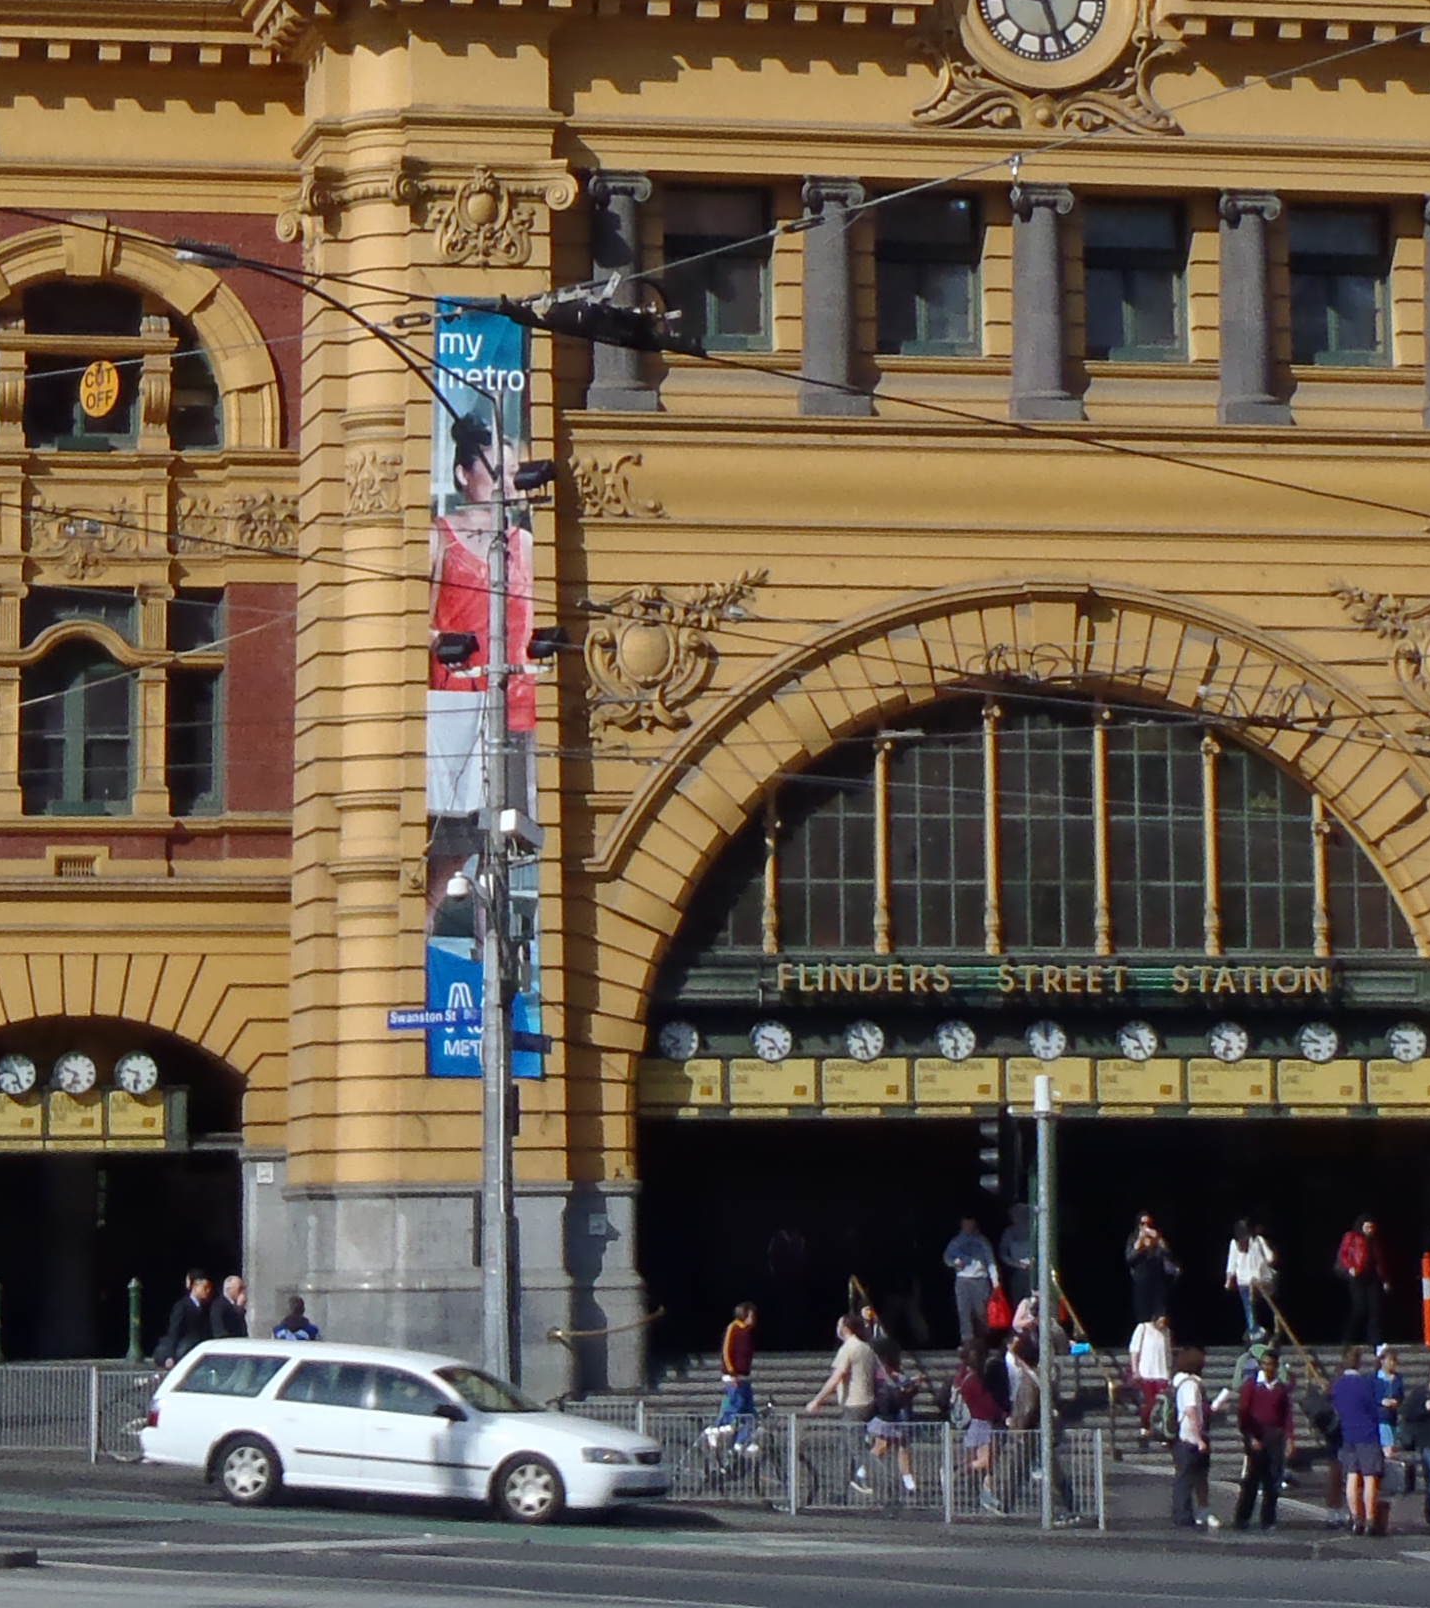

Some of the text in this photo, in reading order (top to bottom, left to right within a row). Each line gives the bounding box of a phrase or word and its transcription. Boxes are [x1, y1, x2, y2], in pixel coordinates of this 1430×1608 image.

[439, 332, 483, 361] my
[85, 367, 114, 388] CUT
[438, 364, 525, 391] metro
[86, 390, 113, 409] OFF
[776, 962, 1331, 993] FLINDERS STREET STATION
[389, 1010, 443, 1024] Swanston
[444, 1008, 457, 1022] St
[443, 1038, 483, 1056] MET
